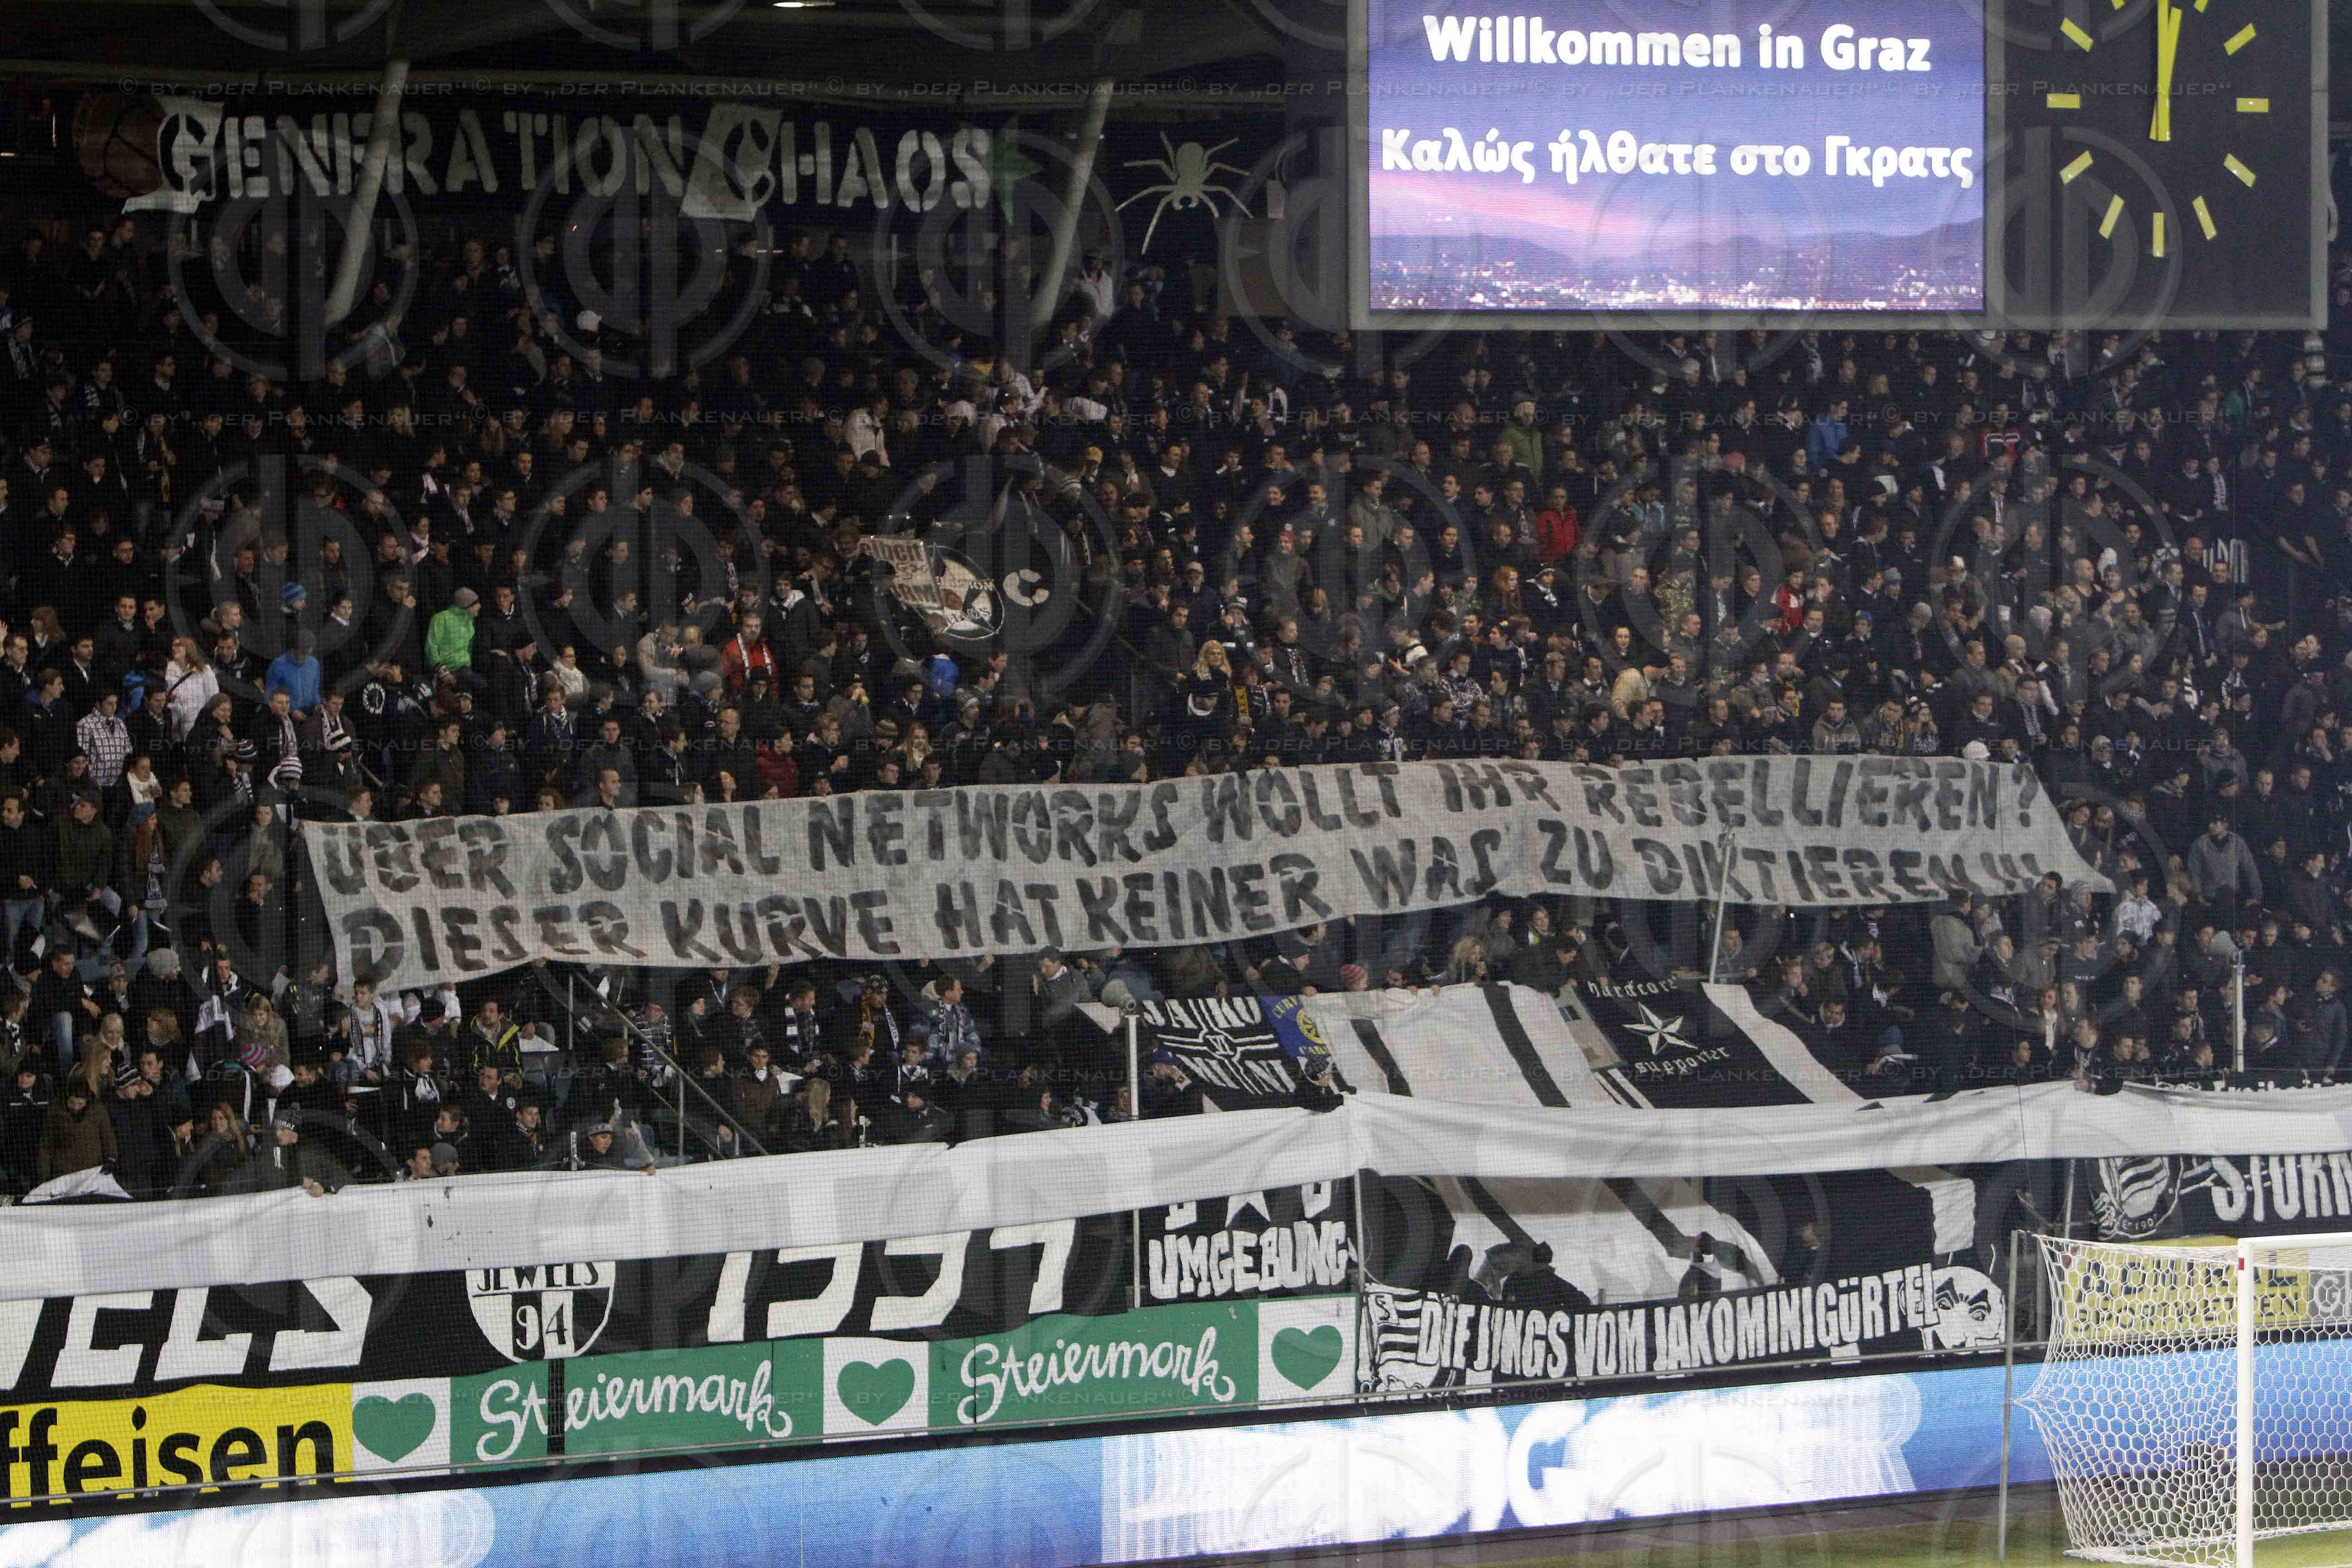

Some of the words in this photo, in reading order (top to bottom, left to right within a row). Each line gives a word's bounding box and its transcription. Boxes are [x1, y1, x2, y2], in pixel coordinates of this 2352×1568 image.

[1422, 15, 1741, 68] Willkommen
[1759, 24, 1804, 69] in
[1820, 24, 1931, 71] Graz
[1381, 127, 1534, 184] Καλώς
[1548, 130, 1717, 185] ήλθατε
[1730, 142, 1811, 176] στο
[1824, 135, 1973, 188] Γκρατς
[546, 804, 781, 894] SOCIAL
[808, 782, 1179, 872] NETWORKS
[1201, 763, 1401, 843] WOLLT
[1436, 759, 1561, 813] IHR
[342, 900, 647, 984] DIESER
[659, 889, 901, 964] KURVE
[935, 881, 1063, 950] HAT
[1074, 853, 1333, 946] KEINER
[1350, 828, 1501, 909] WAS
[1537, 819, 1614, 890] ZU
[1148, 1220, 1346, 1299] UMGEBUNG
[2076, 1250, 2298, 1303] ADMIRL
[516, 1302, 568, 1350] 94
[1416, 1299, 1475, 1368] DIE
[1574, 1308, 1646, 1377] VOM
[1653, 1263, 1938, 1371] JAKOMINIGÜRTEL
[476, 1360, 793, 1462] Steiermark
[957, 1326, 1236, 1424] Steiermark
